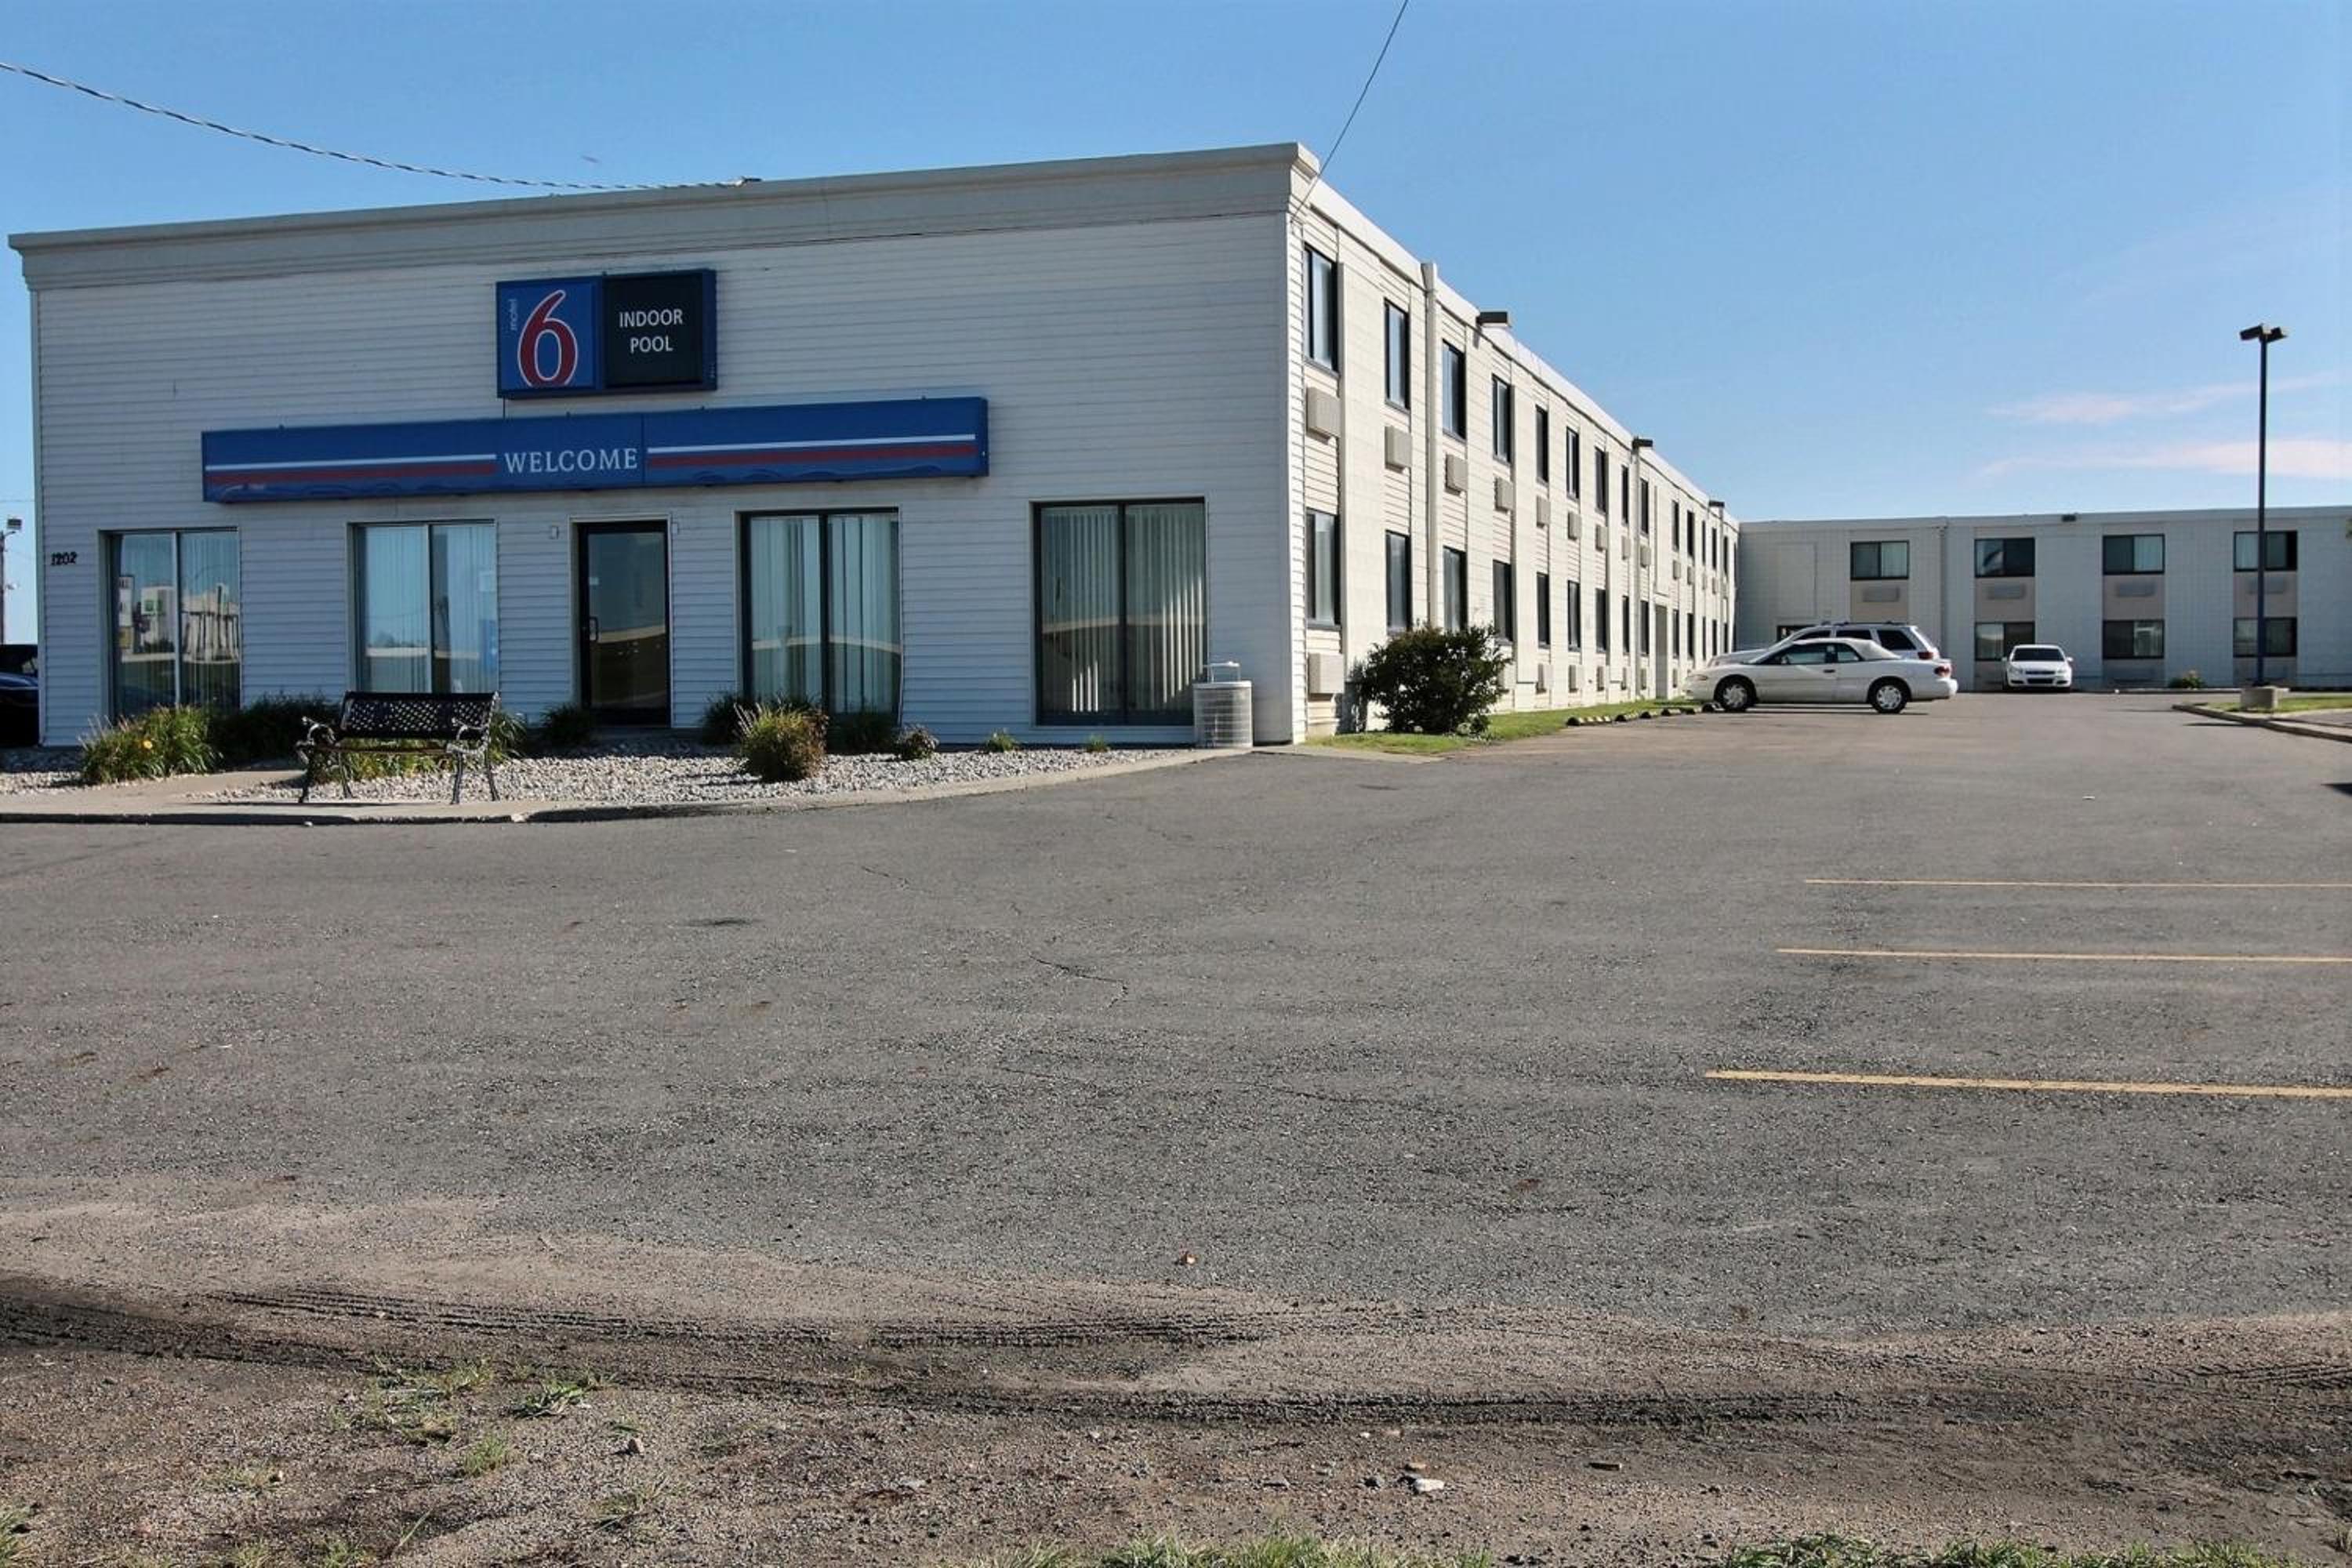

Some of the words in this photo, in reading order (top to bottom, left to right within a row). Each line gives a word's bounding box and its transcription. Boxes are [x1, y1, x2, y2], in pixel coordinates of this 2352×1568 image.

[619, 308, 684, 328] INDOOR
[517, 289, 579, 386] 6
[630, 336, 673, 354] POOL
[504, 448, 638, 474] WELCOME
[50, 551, 78, 566] 1202
